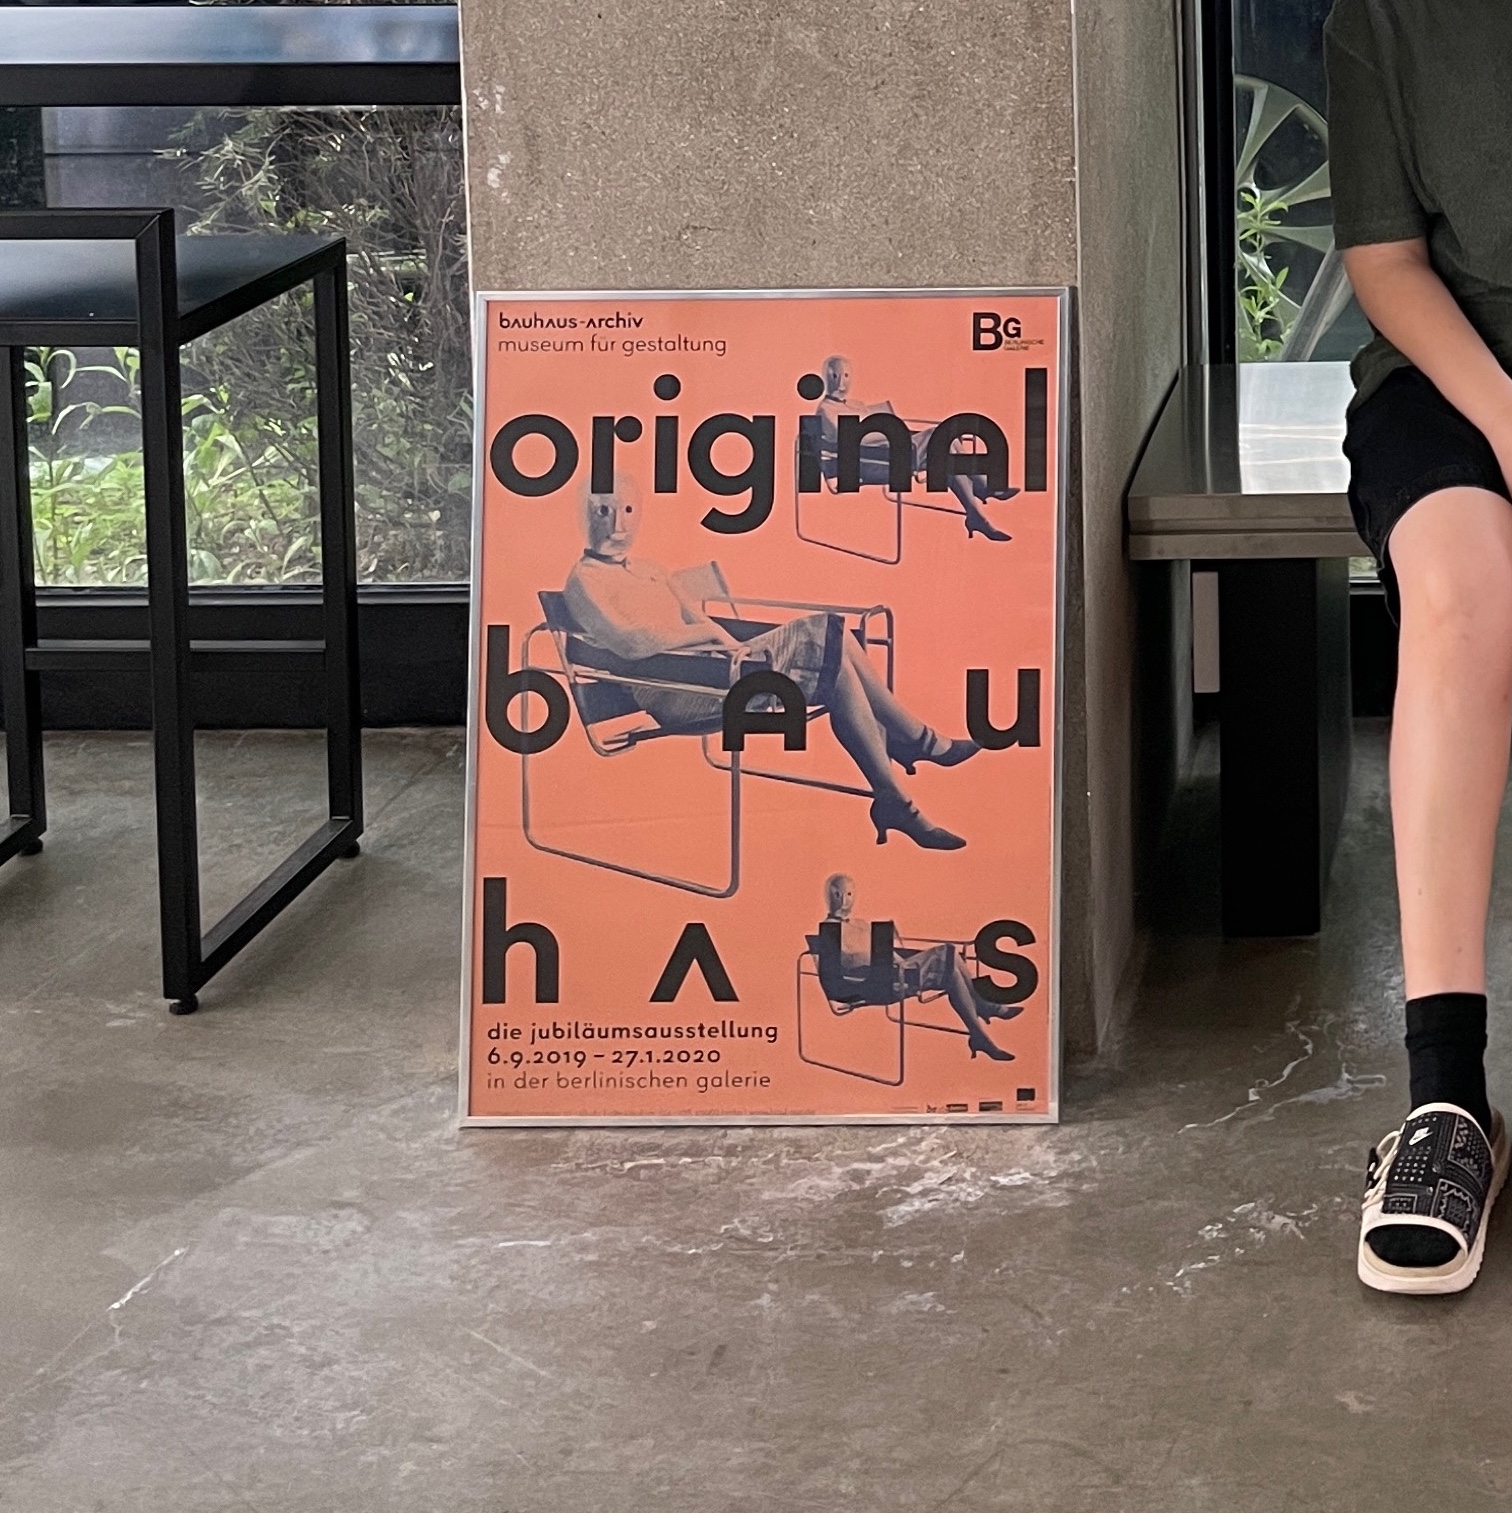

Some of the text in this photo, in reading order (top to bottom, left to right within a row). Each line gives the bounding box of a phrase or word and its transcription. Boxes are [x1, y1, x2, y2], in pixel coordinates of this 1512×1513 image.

[498, 311, 644, 330] bauhaus-archiv
[972, 312, 1022, 351] BG
[497, 333, 727, 357] museum für gestaltung
[489, 366, 1048, 535] original
[487, 1019, 779, 1045] die jubiläumsausstellung
[487, 1047, 587, 1068] 6.9.2019
[611, 1049, 721, 1068] 27.1.2020
[487, 1069, 771, 1093] in der berlinischen galerie
